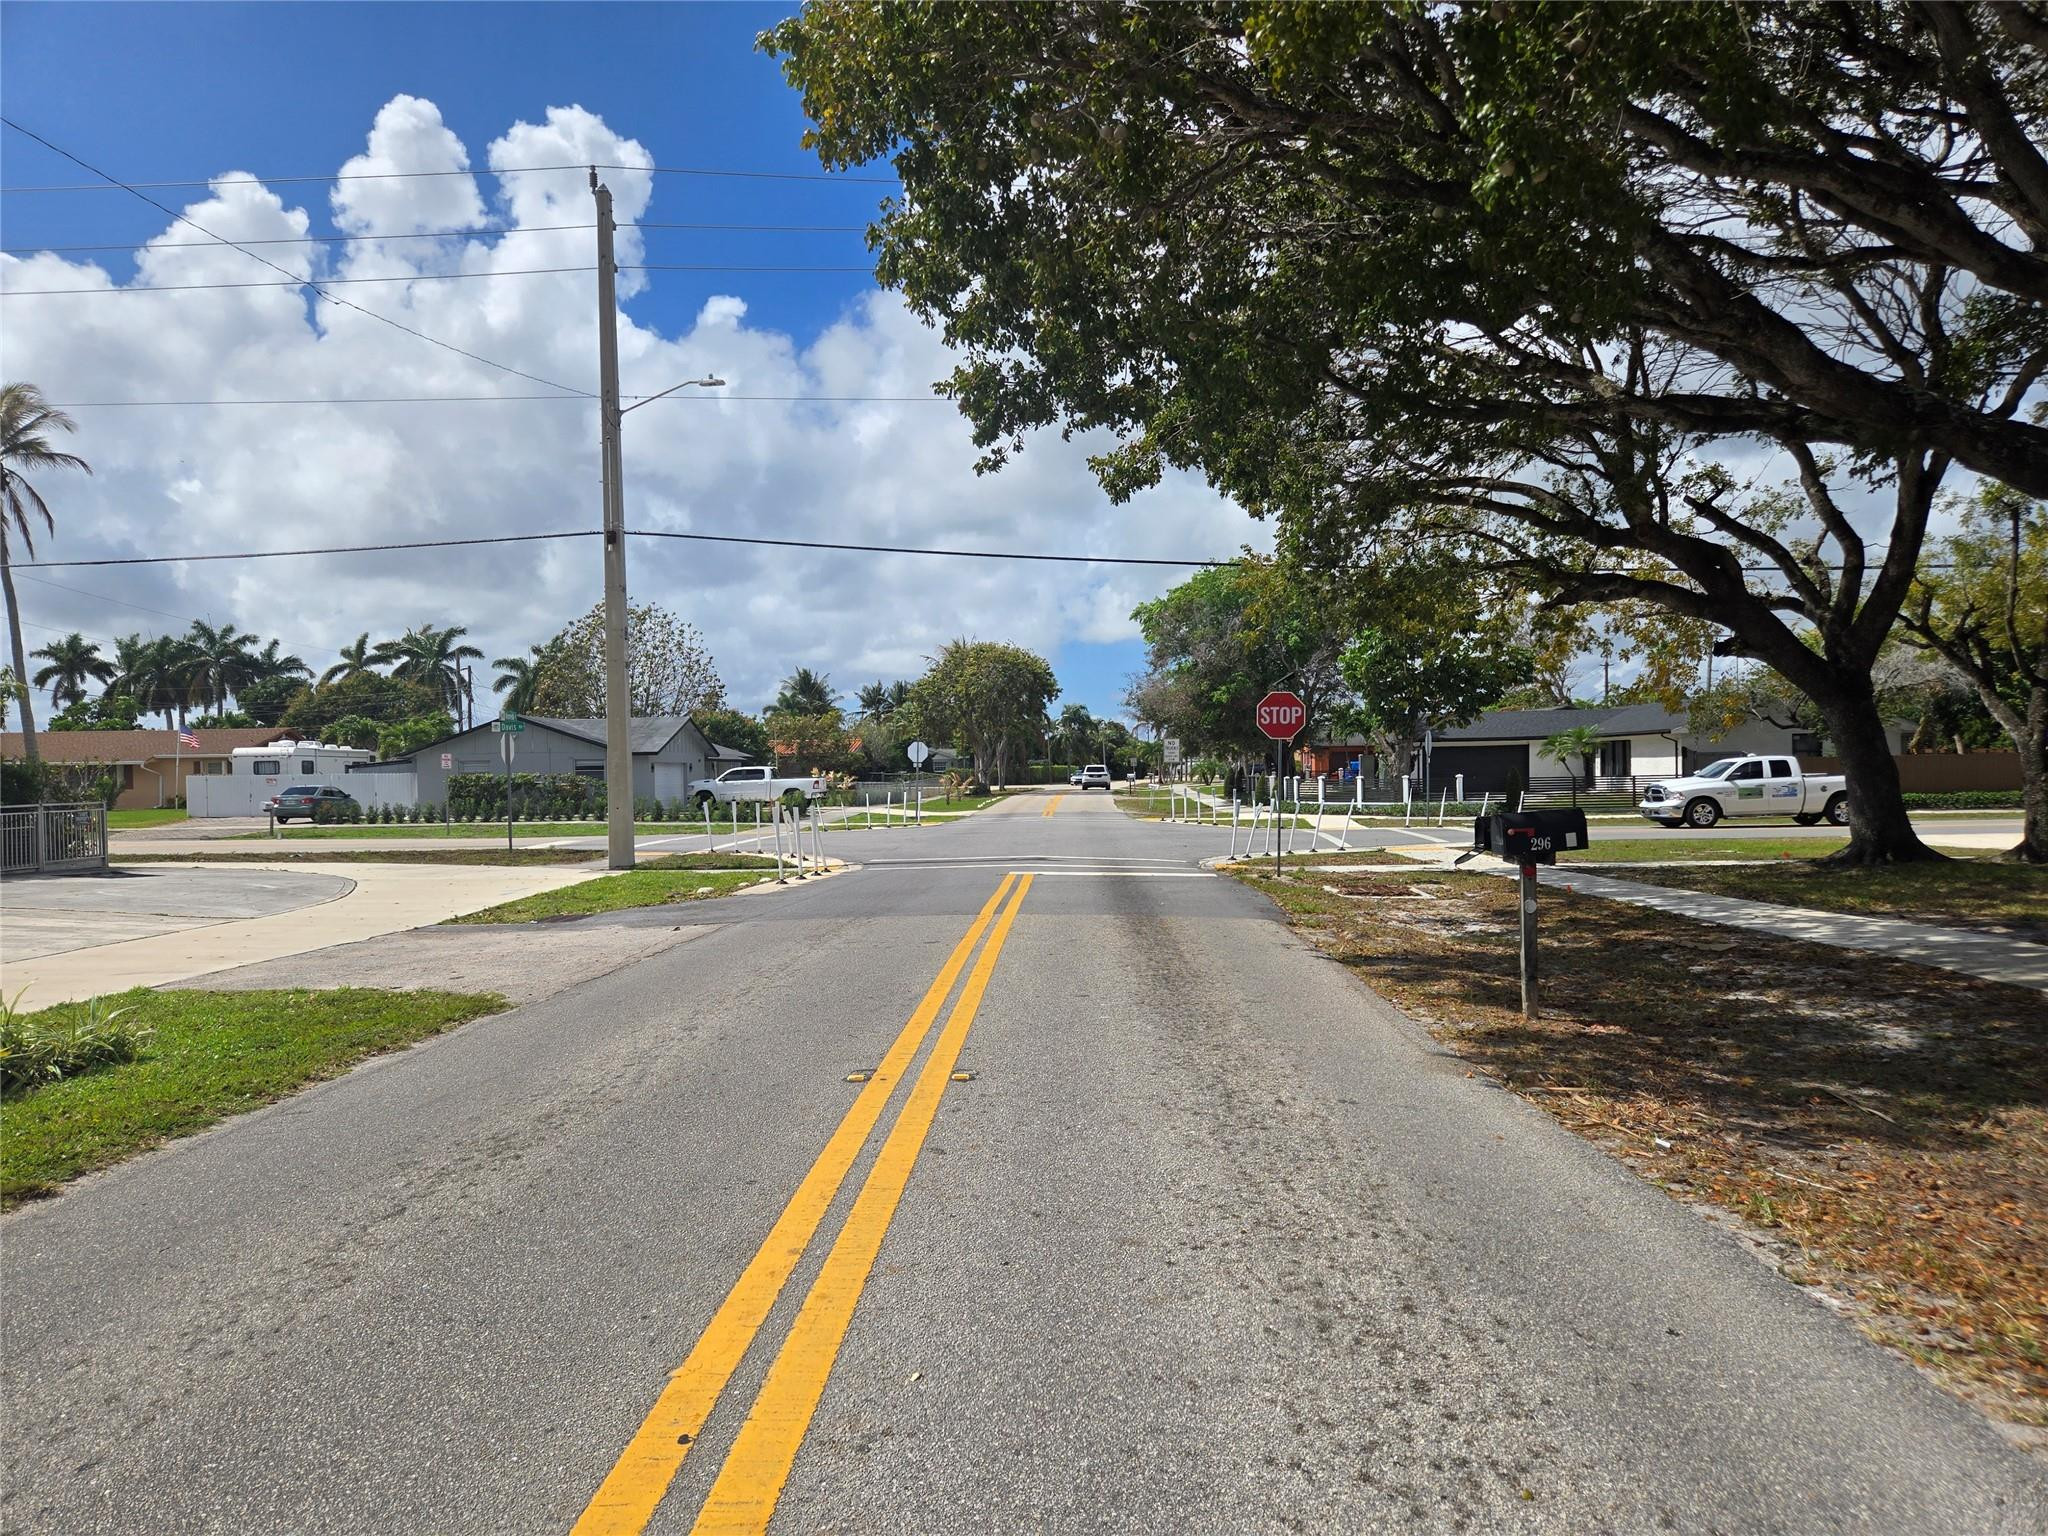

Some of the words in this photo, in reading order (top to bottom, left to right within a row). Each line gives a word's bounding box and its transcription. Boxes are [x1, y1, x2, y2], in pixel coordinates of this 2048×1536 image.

[1260, 706, 1302, 725] STOP
[501, 723, 517, 731] Davis
[1530, 837, 1551, 851] 296
